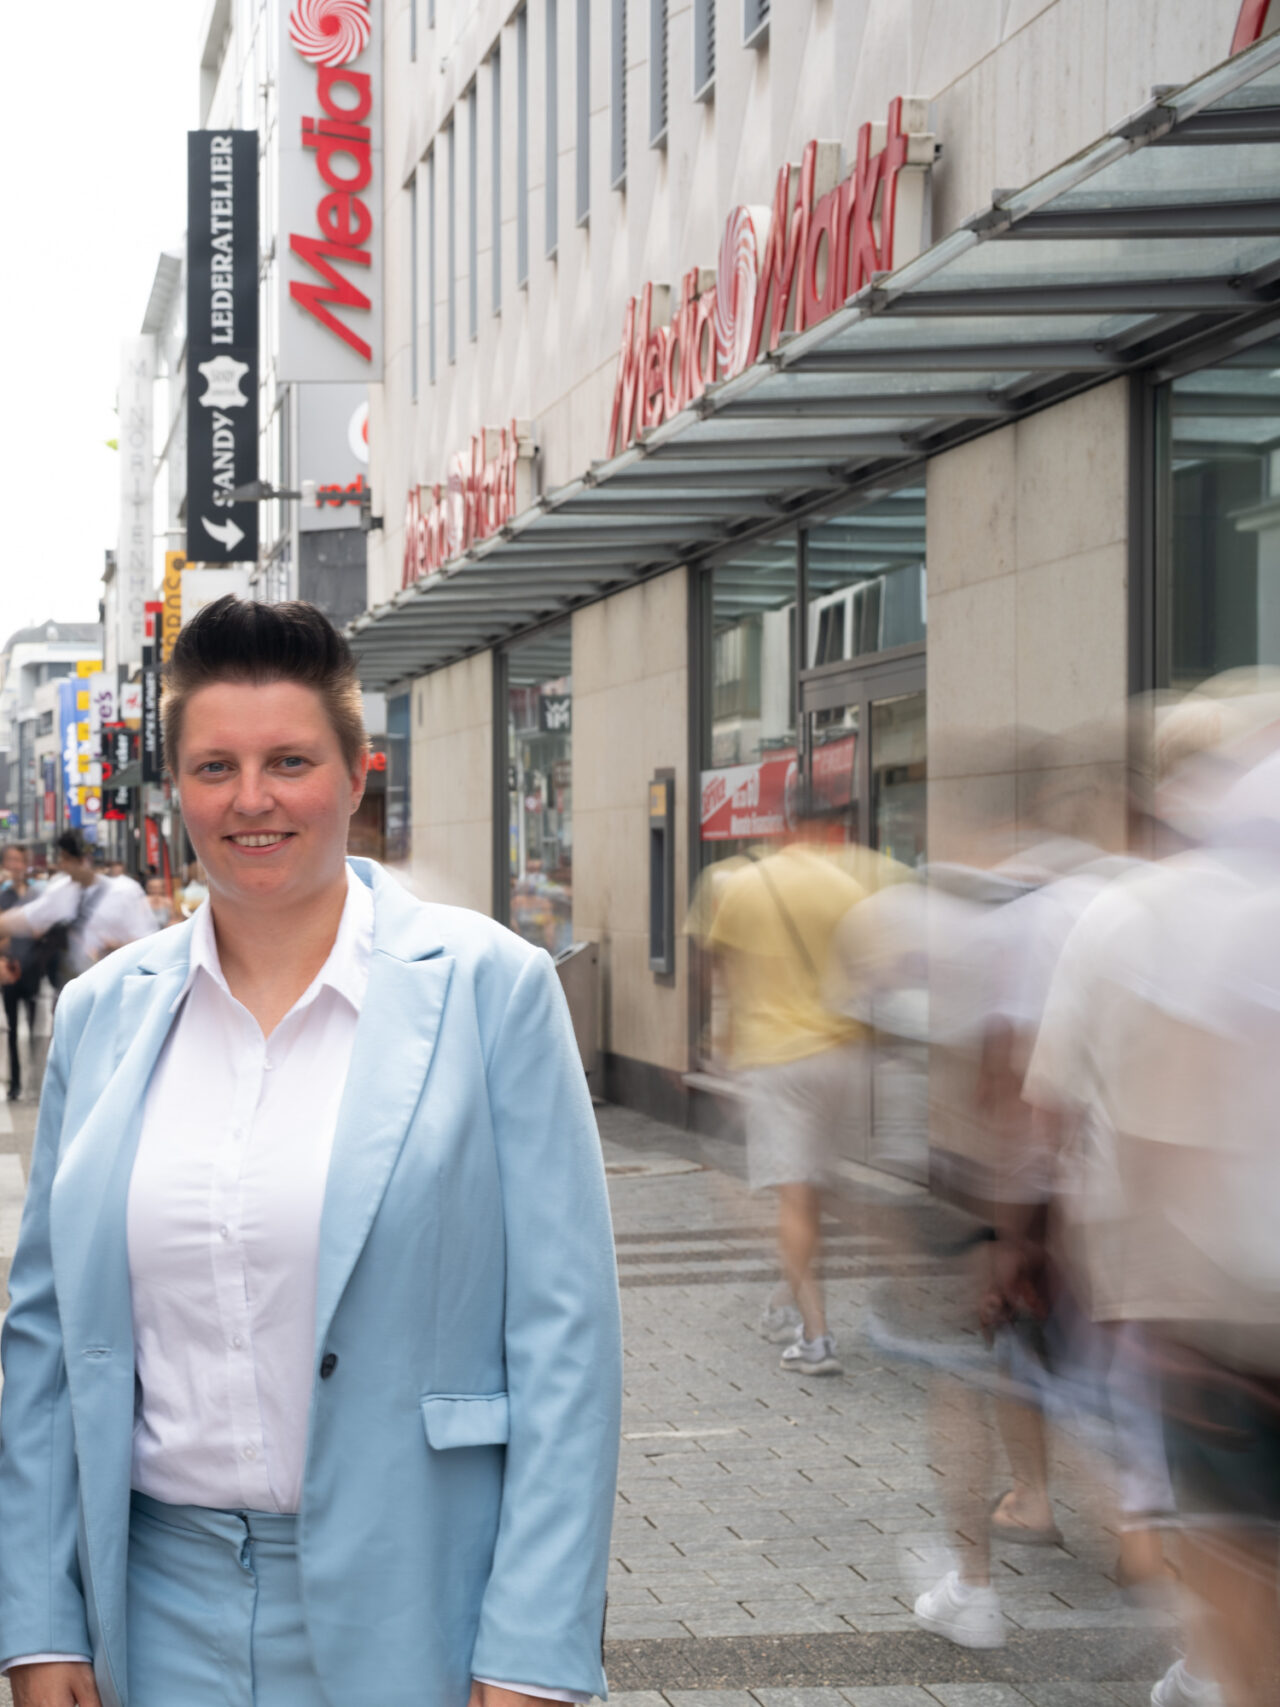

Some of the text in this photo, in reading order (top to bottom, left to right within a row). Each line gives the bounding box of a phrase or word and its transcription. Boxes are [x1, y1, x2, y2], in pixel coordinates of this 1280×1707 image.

[211, 136, 235, 345] LEDERATELIER
[288, 65, 373, 363] Media
[211, 411, 235, 508] SANDY
